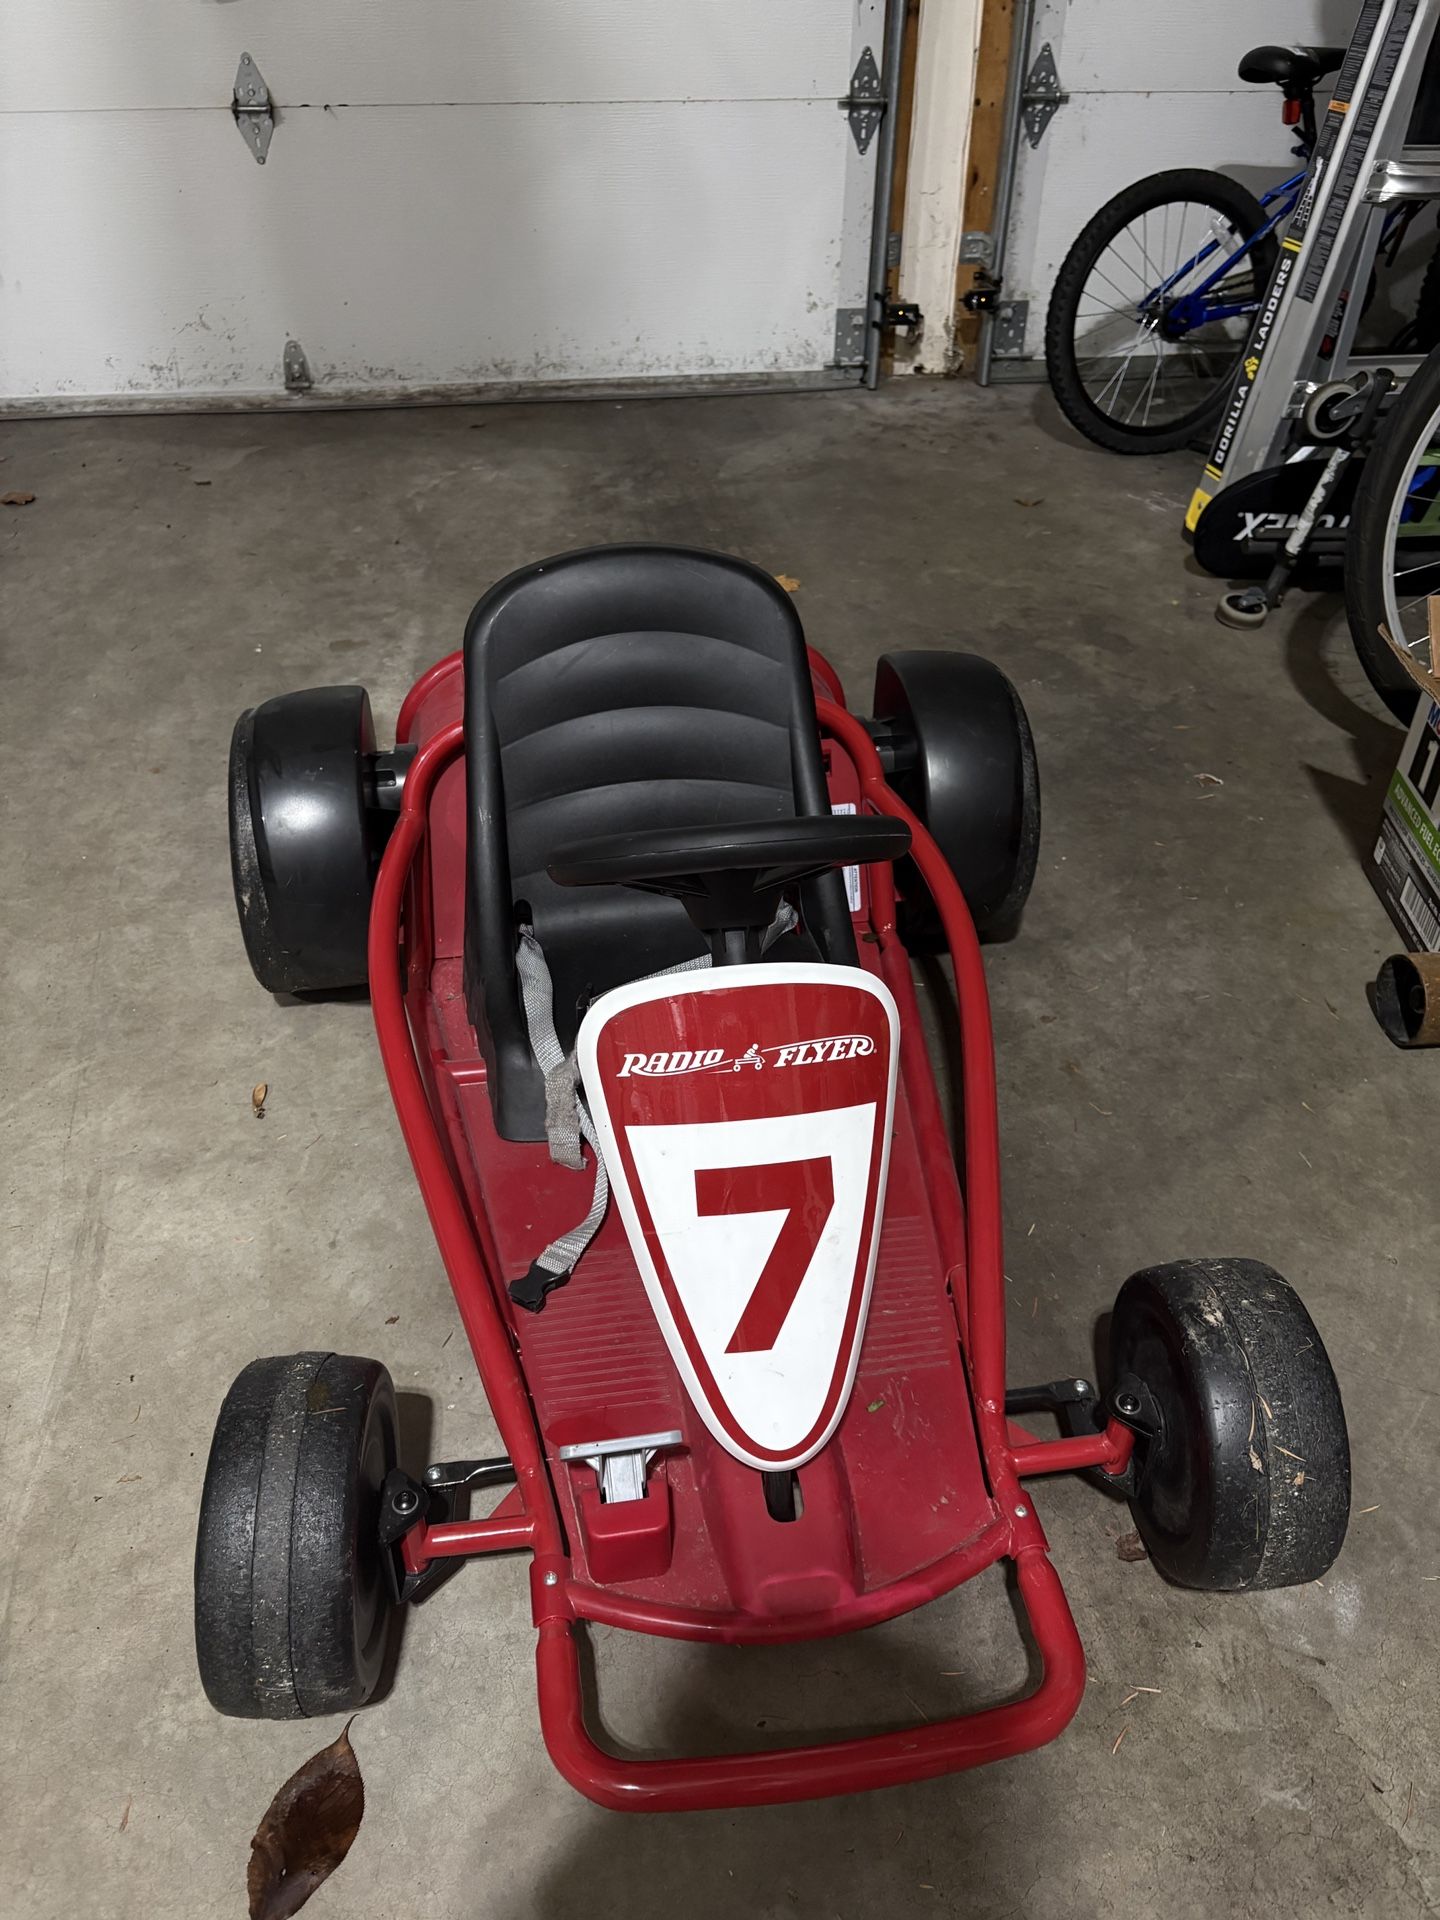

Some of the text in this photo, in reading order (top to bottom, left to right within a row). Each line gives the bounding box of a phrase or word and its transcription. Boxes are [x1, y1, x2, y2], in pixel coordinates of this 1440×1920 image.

[1214, 258, 1292, 464] GORILLA LADDERS
[1418, 741, 1439, 794] 1
[1394, 783, 1422, 829] ADVANCED
[1419, 822, 1435, 849] FUEL
[616, 1034, 875, 1078] RADIO FLYER
[694, 1155, 836, 1354] 7
